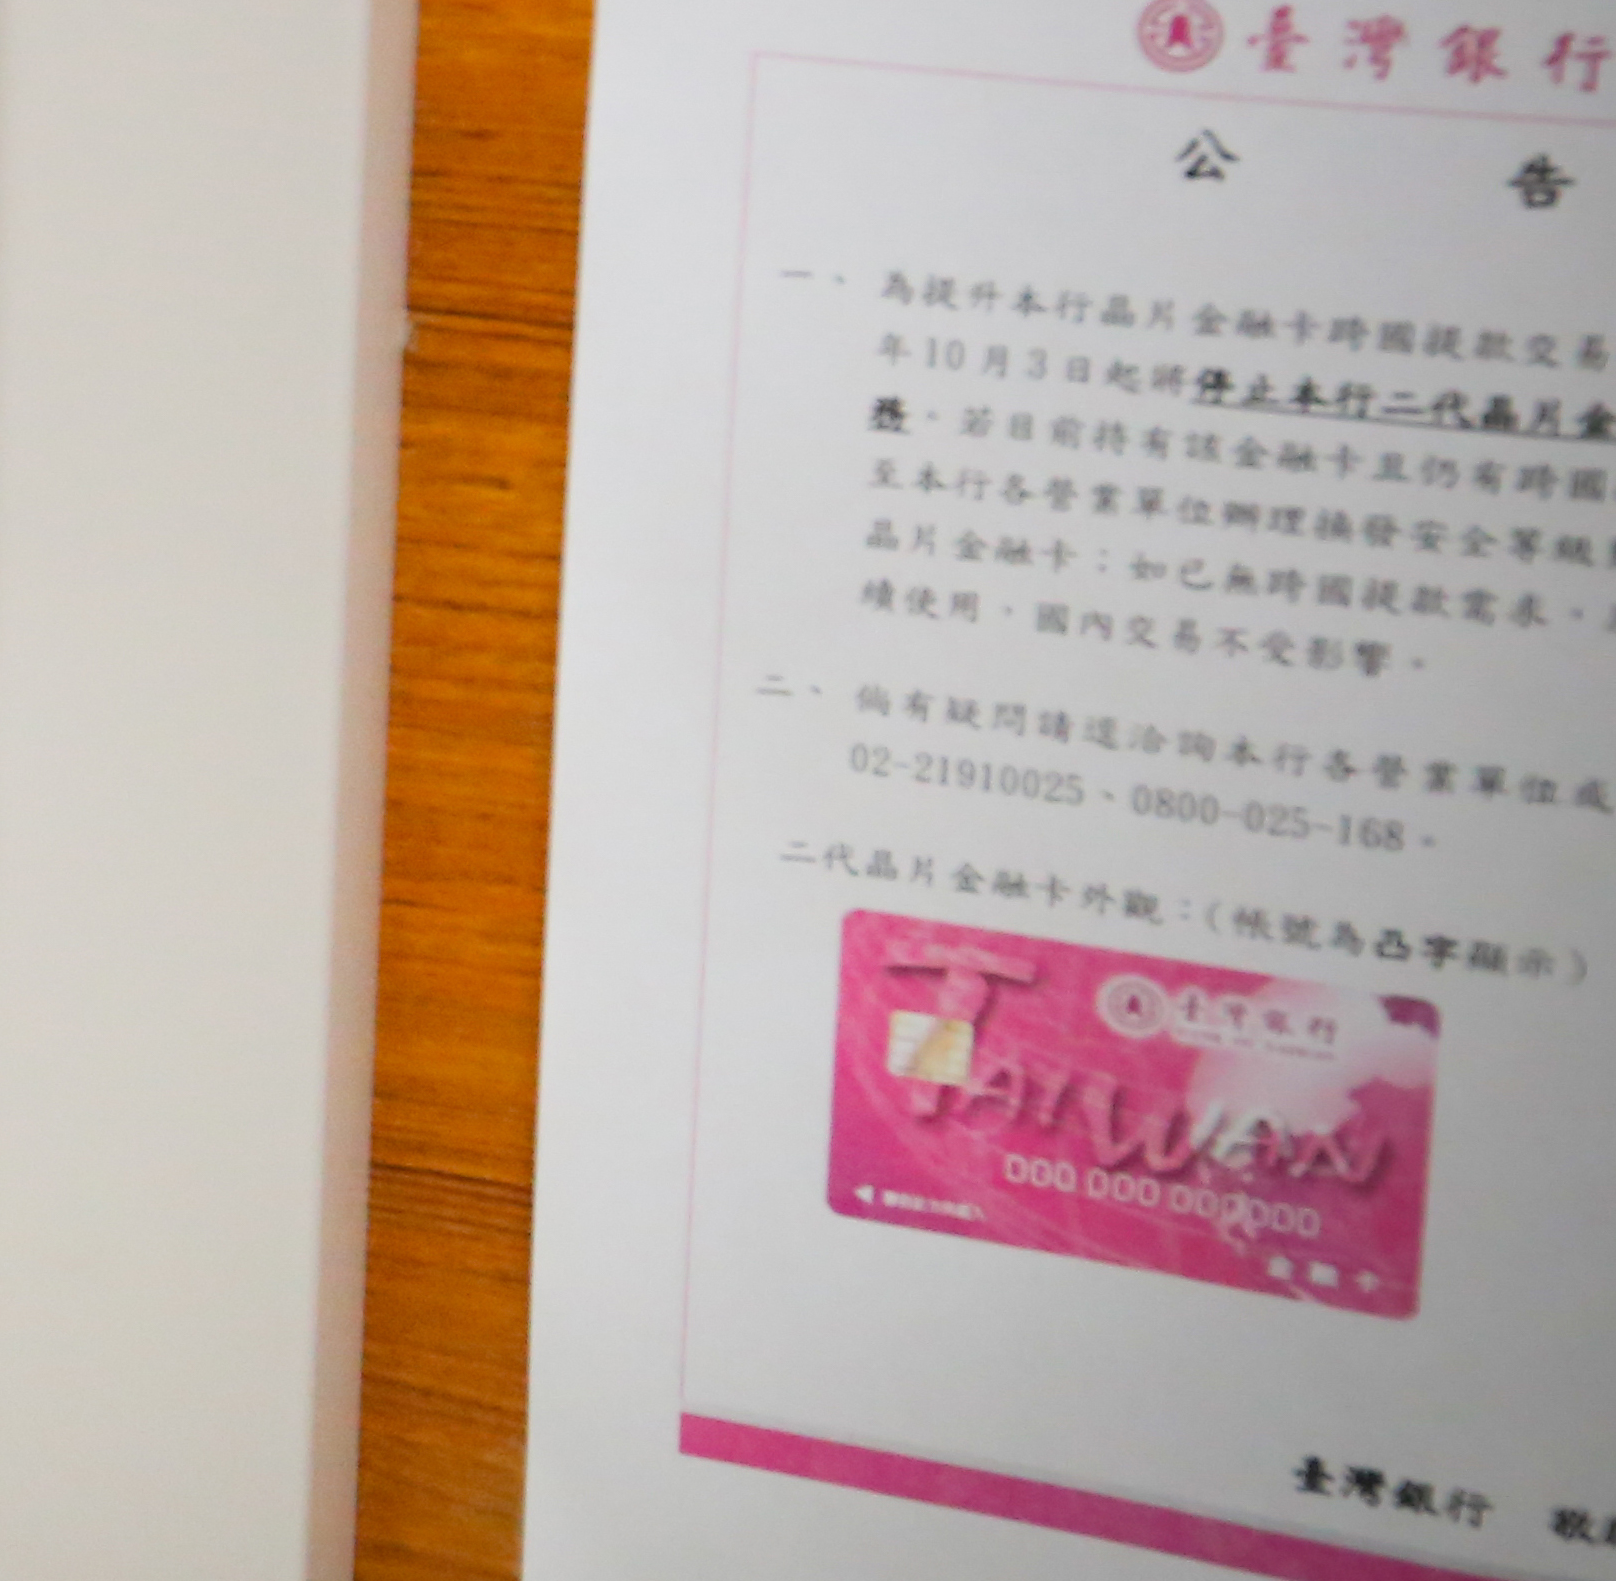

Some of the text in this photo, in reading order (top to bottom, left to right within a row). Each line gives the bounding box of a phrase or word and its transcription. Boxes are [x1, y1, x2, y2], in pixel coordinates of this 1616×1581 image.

[1247, 4, 1611, 92] 臺灣銀行
[1175, 128, 1577, 210] 公 告
